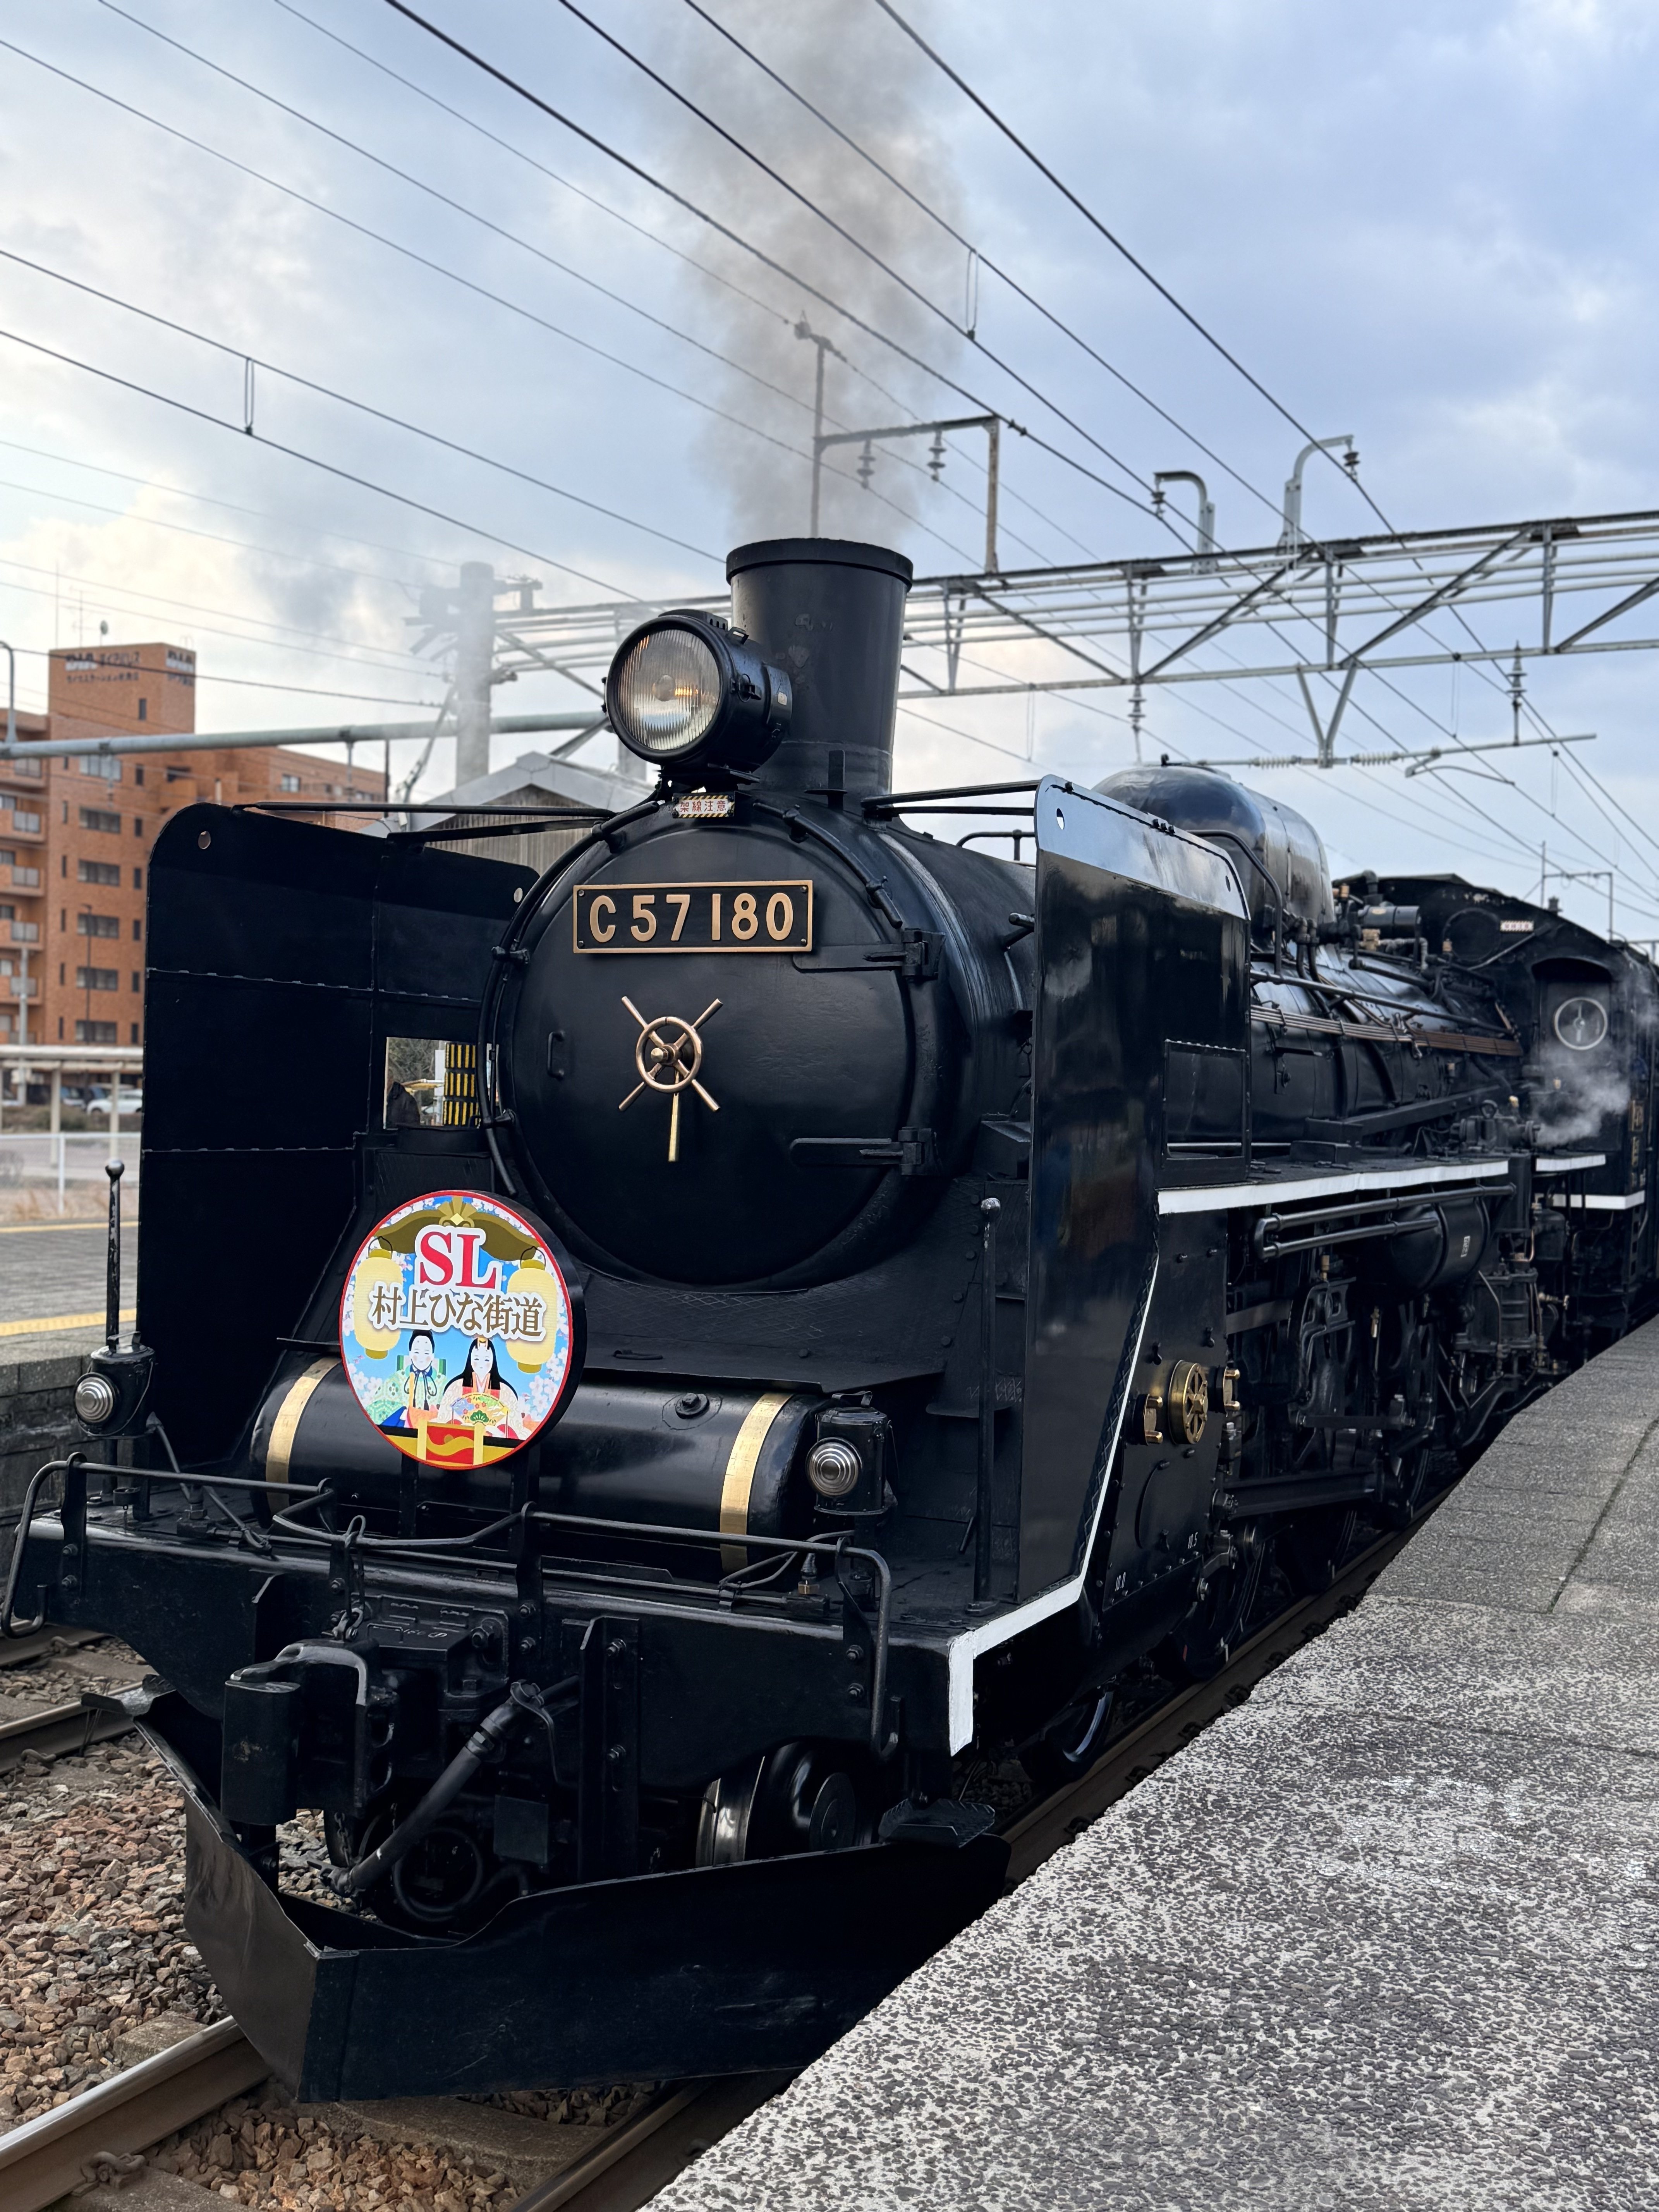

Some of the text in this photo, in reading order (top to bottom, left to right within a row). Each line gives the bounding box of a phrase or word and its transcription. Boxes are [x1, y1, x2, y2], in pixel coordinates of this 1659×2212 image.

[680, 800, 726, 812] 架線注意
[711, 893, 793, 941] 180
[419, 1231, 497, 1289] SL
[372, 1285, 543, 1337] 村上ひな街道
